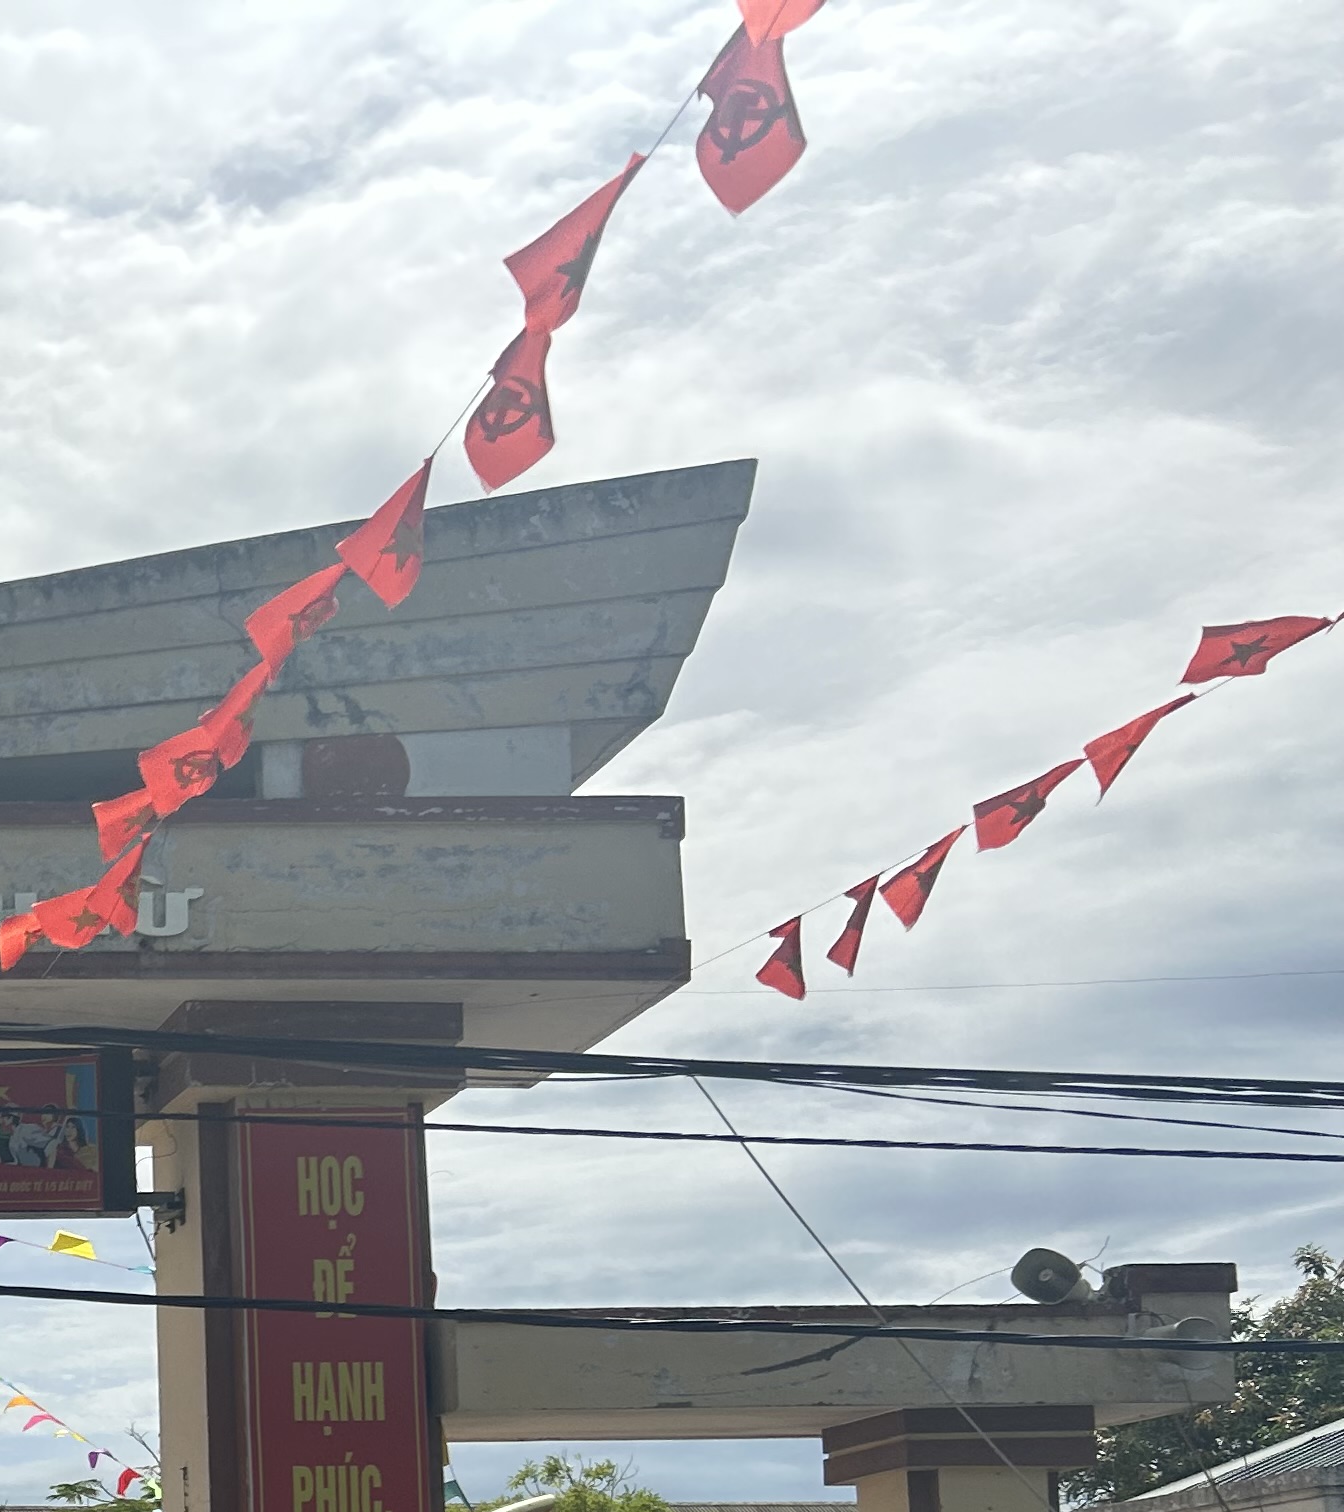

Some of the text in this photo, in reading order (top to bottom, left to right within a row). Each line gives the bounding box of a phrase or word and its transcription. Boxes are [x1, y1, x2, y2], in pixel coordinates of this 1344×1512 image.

[84, 876, 205, 939] Ừ
[296, 1155, 365, 1231] HỌC
[312, 1233, 357, 1319] ĐỂ
[292, 1361, 386, 1437] HẠNH
